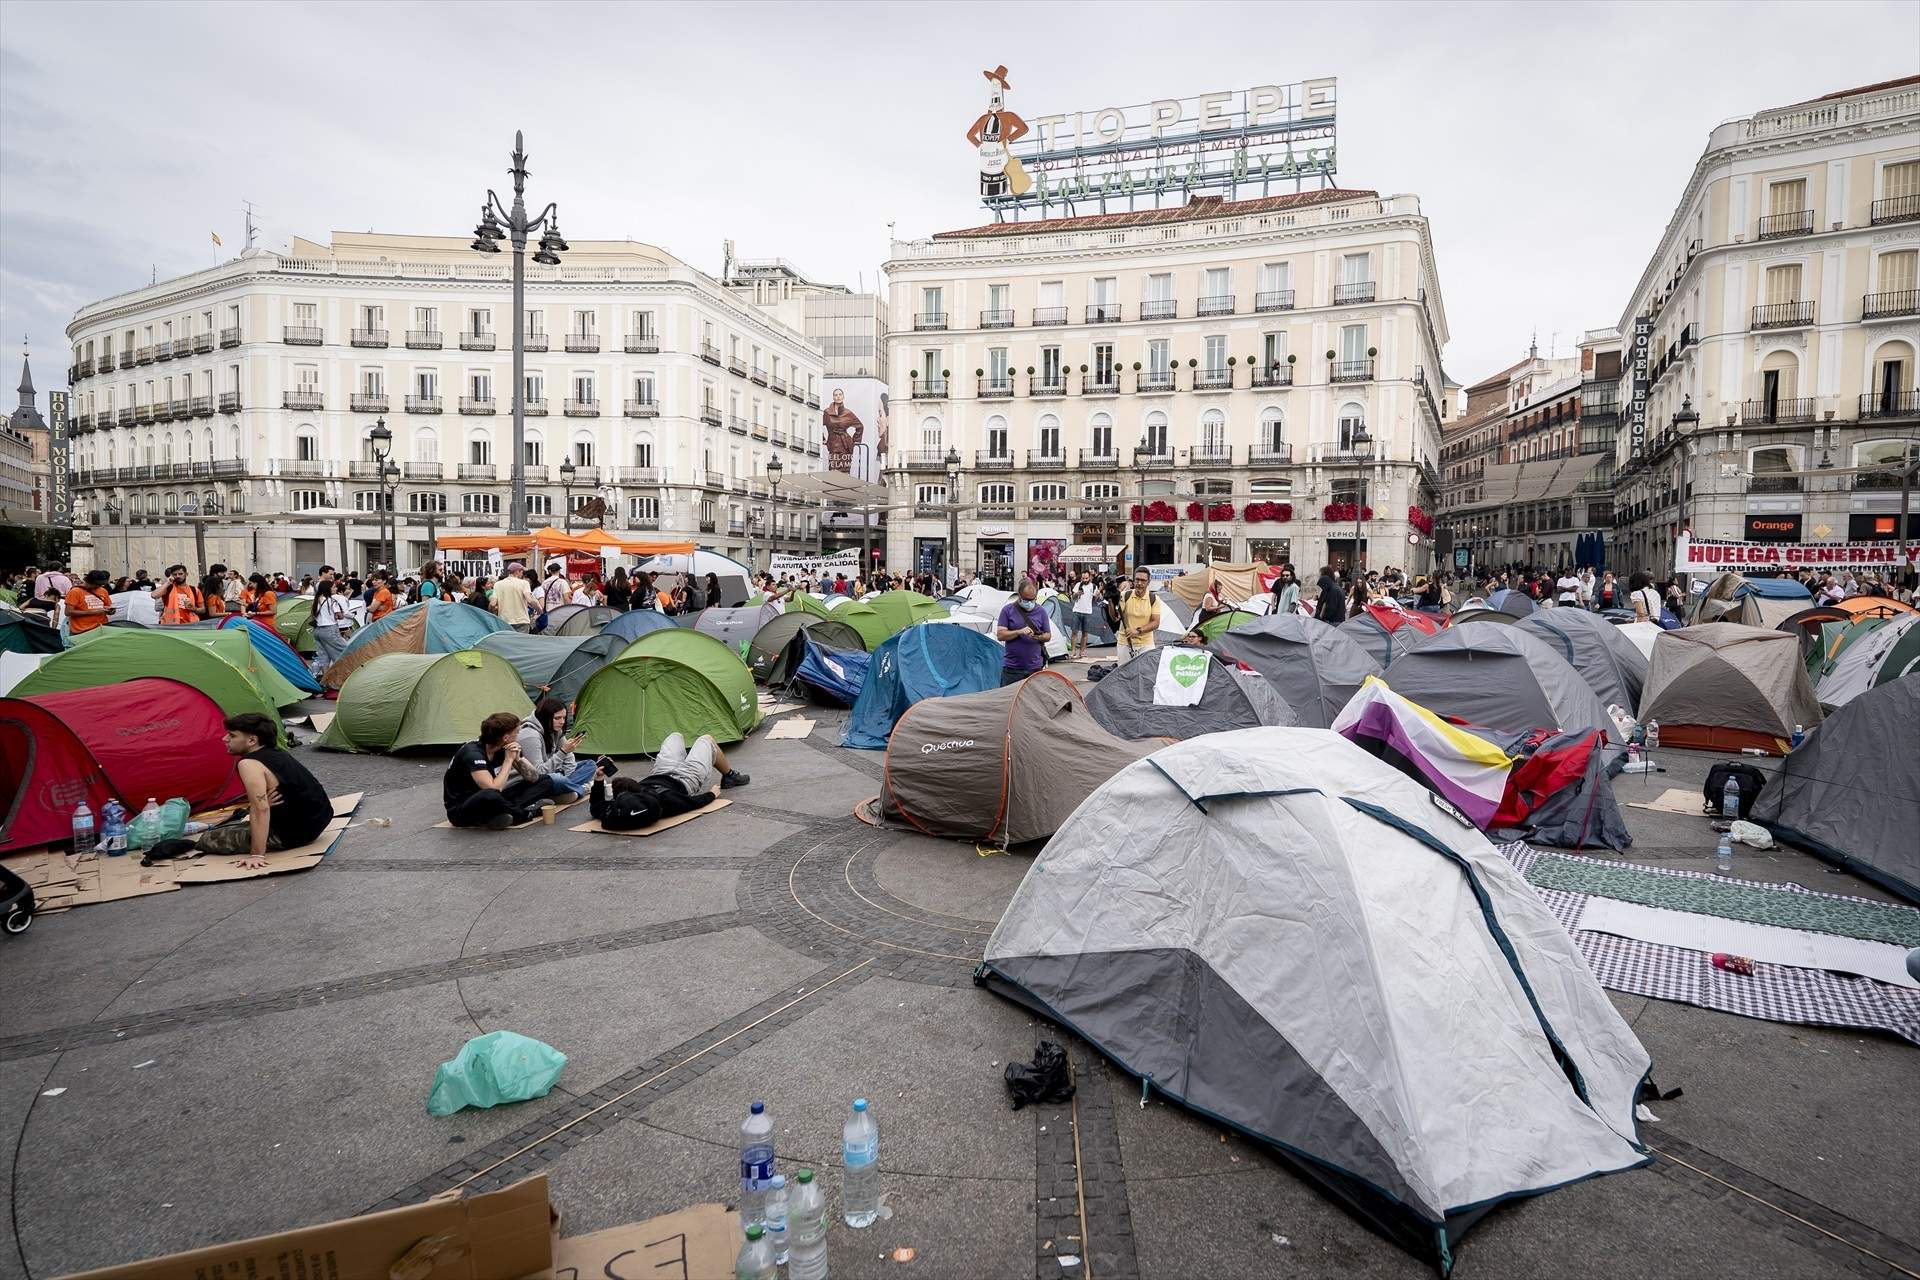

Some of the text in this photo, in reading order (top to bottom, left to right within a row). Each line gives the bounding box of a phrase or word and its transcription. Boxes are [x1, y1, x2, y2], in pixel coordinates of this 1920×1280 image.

[1036, 77, 1337, 152] TIO PEPE
[1033, 158, 1064, 172] SOL
[1071, 156, 1089, 167] DE
[1036, 161, 1200, 200] GONZALEZ
[1631, 324, 1648, 458] HOTEL EUROPA
[52, 392, 67, 513] HOTEL MODERNO
[1752, 521, 1794, 530] Orange
[1688, 545, 1920, 563] HUELGA GENERAL Y
[444, 561, 492, 578] CONTRA
[921, 740, 974, 754] Quechua
